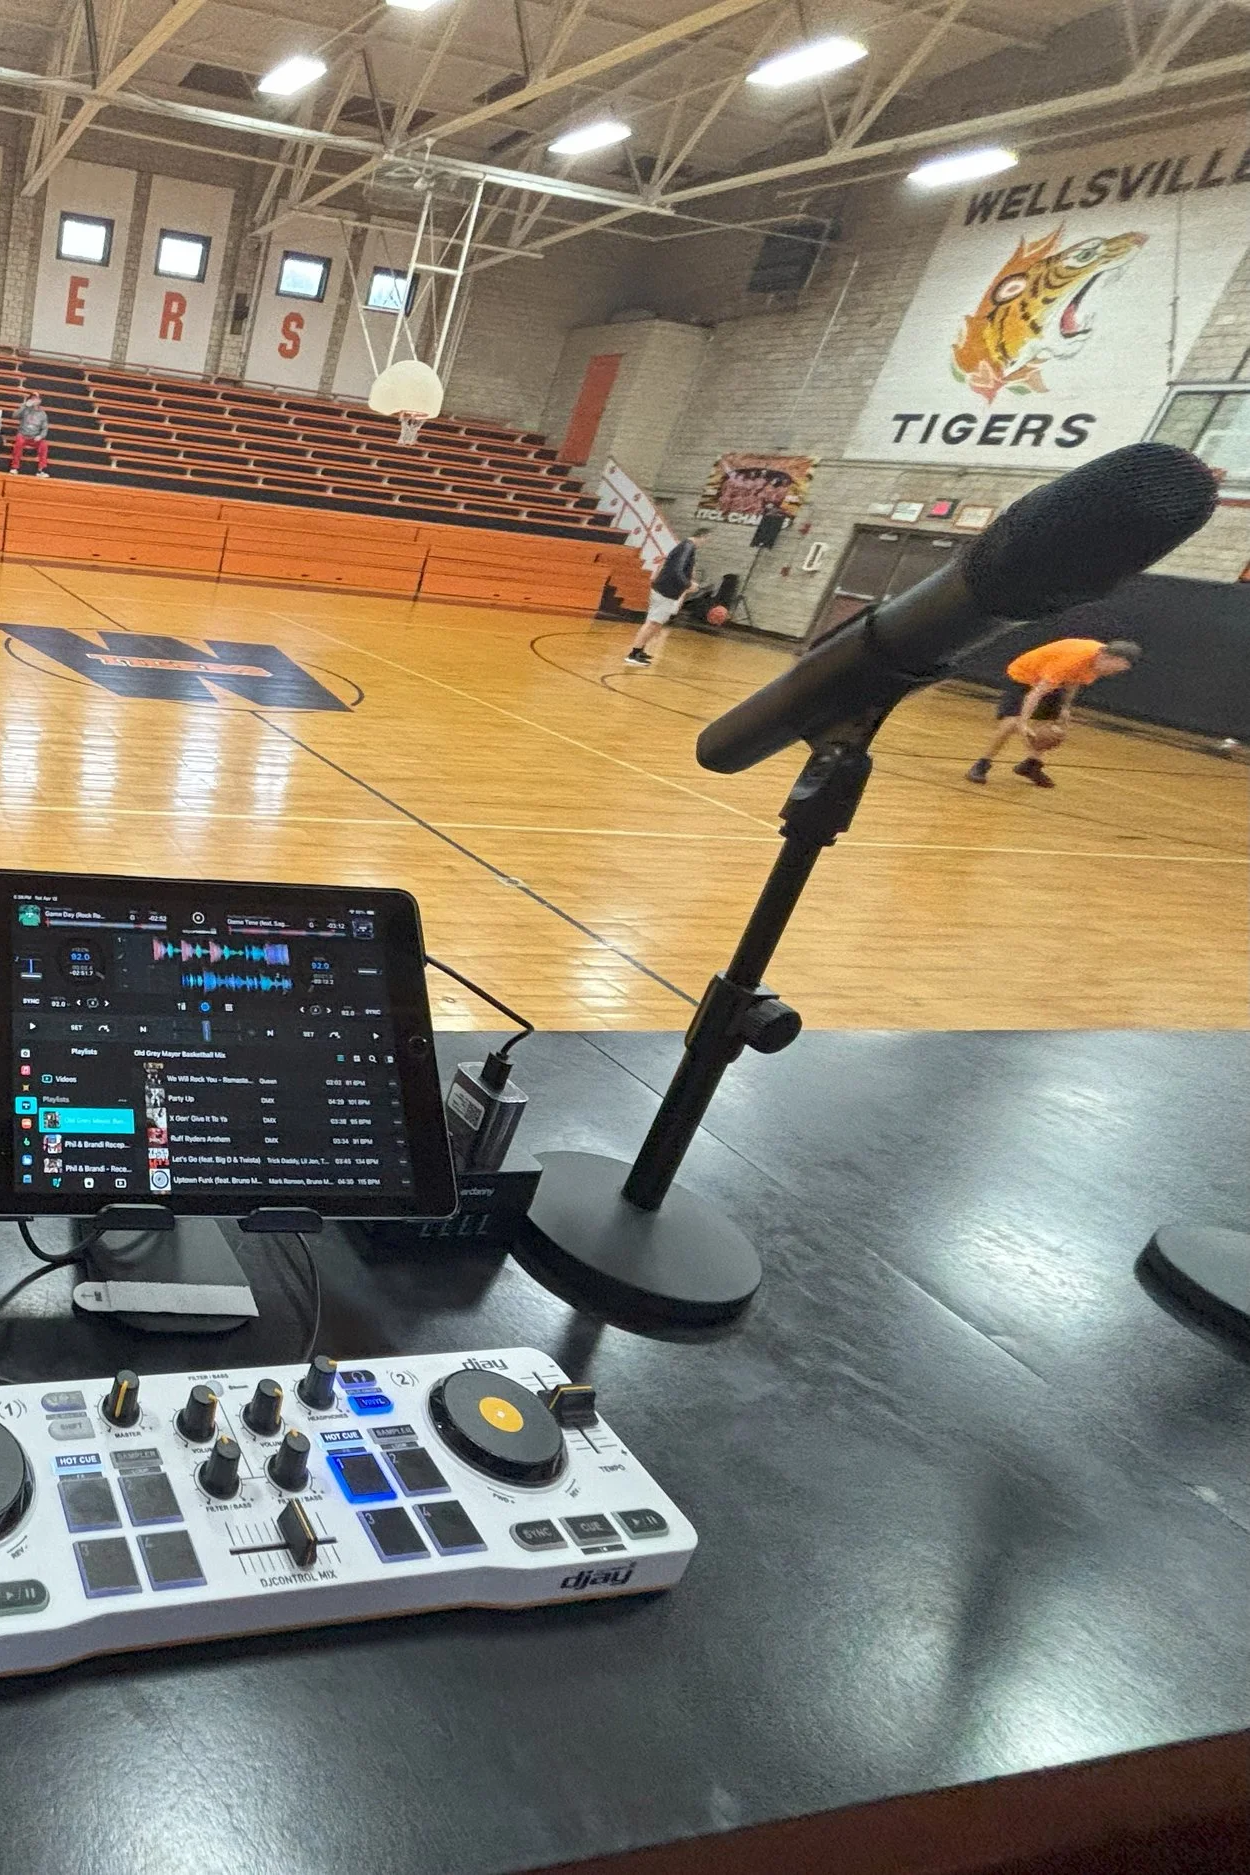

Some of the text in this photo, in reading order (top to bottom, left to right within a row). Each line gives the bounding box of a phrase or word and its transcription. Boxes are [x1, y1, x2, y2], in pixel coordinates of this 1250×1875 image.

[892, 412, 1097, 449] TIGERS
[63, 911, 74, 919] Day
[70, 953, 91, 961] 92.0
[71, 1047, 98, 1057] Playlists
[133, 1049, 145, 1057] Old
[146, 1050, 161, 1058] Grey
[182, 1050, 214, 1058] Basketball
[55, 1075, 77, 1083] Videos
[190, 1075, 205, 1083] Rock
[42, 1095, 70, 1104] Playlists
[168, 1095, 184, 1103] Party
[64, 1140, 77, 1148] Phil
[172, 1155, 187, 1163] Let's
[215, 1156, 226, 1165] Big
[173, 1176, 197, 1185] Uptown
[307, 1413, 349, 1422] HEADPHONES
[60, 1422, 83, 1430] SHIFT
[114, 1431, 141, 1439] MASTER
[324, 1432, 359, 1441] HOT CUE
[60, 1455, 97, 1465] HOT CUE
[336, 1458, 345, 1469] 1
[390, 1454, 398, 1464] 2
[599, 1463, 627, 1473] TEMPO
[304, 1494, 323, 1502] BASS
[206, 1502, 252, 1513] FILTER BASS
[422, 1505, 432, 1517] 4
[366, 1512, 376, 1525] 3
[580, 1520, 605, 1531] CUE
[523, 1526, 551, 1539] SYNC
[80, 1543, 90, 1557] 3
[260, 1570, 338, 1588] DJCONTROL MIX
[560, 1561, 638, 1591] djay
